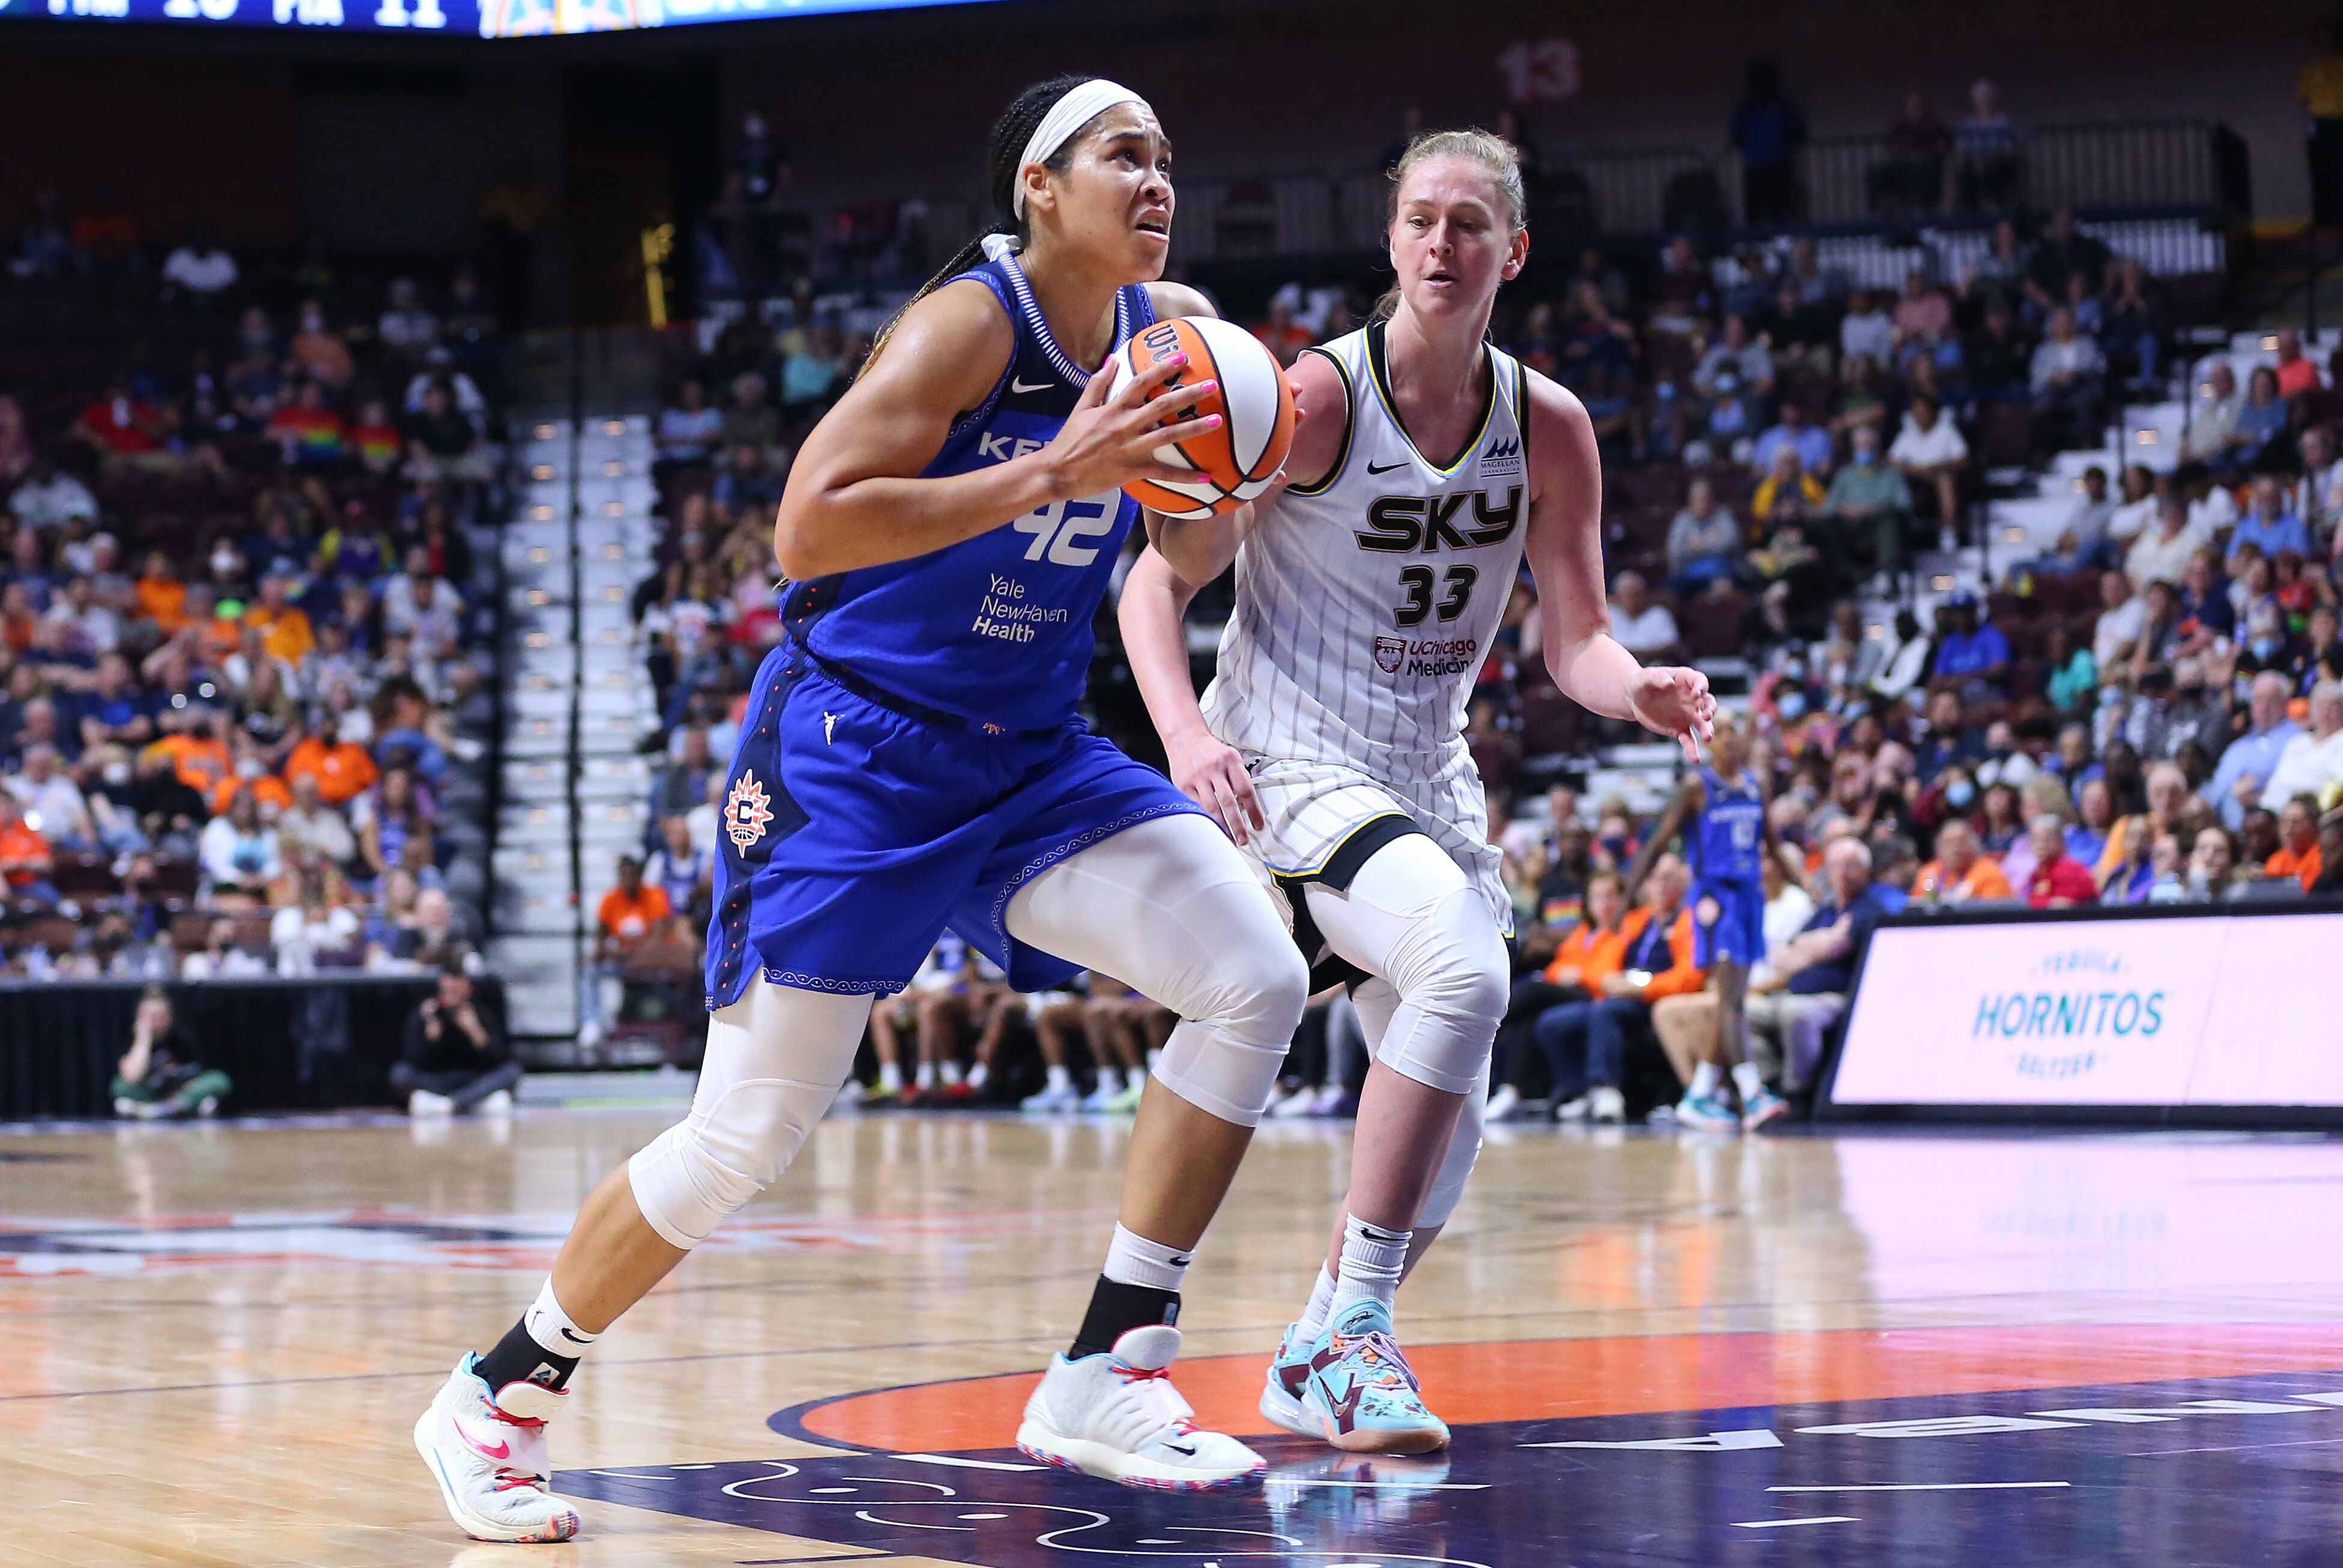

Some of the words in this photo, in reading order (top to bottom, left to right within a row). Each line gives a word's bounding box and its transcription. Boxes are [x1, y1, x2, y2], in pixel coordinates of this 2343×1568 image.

[1498, 42, 1578, 100] 13
[1481, 459, 1519, 468] MAGELLAN
[1013, 487, 1122, 567] 42
[1353, 484, 1524, 553] SKY
[990, 573, 1025, 599] Yale
[1393, 564, 1479, 627] 33
[980, 595, 1068, 623] NewHaven
[971, 616, 1035, 643] Health
[1409, 639, 1477, 656] UChicago
[1406, 657, 1474, 677] Medicin
[1972, 991, 2165, 1037] HORNITOS
